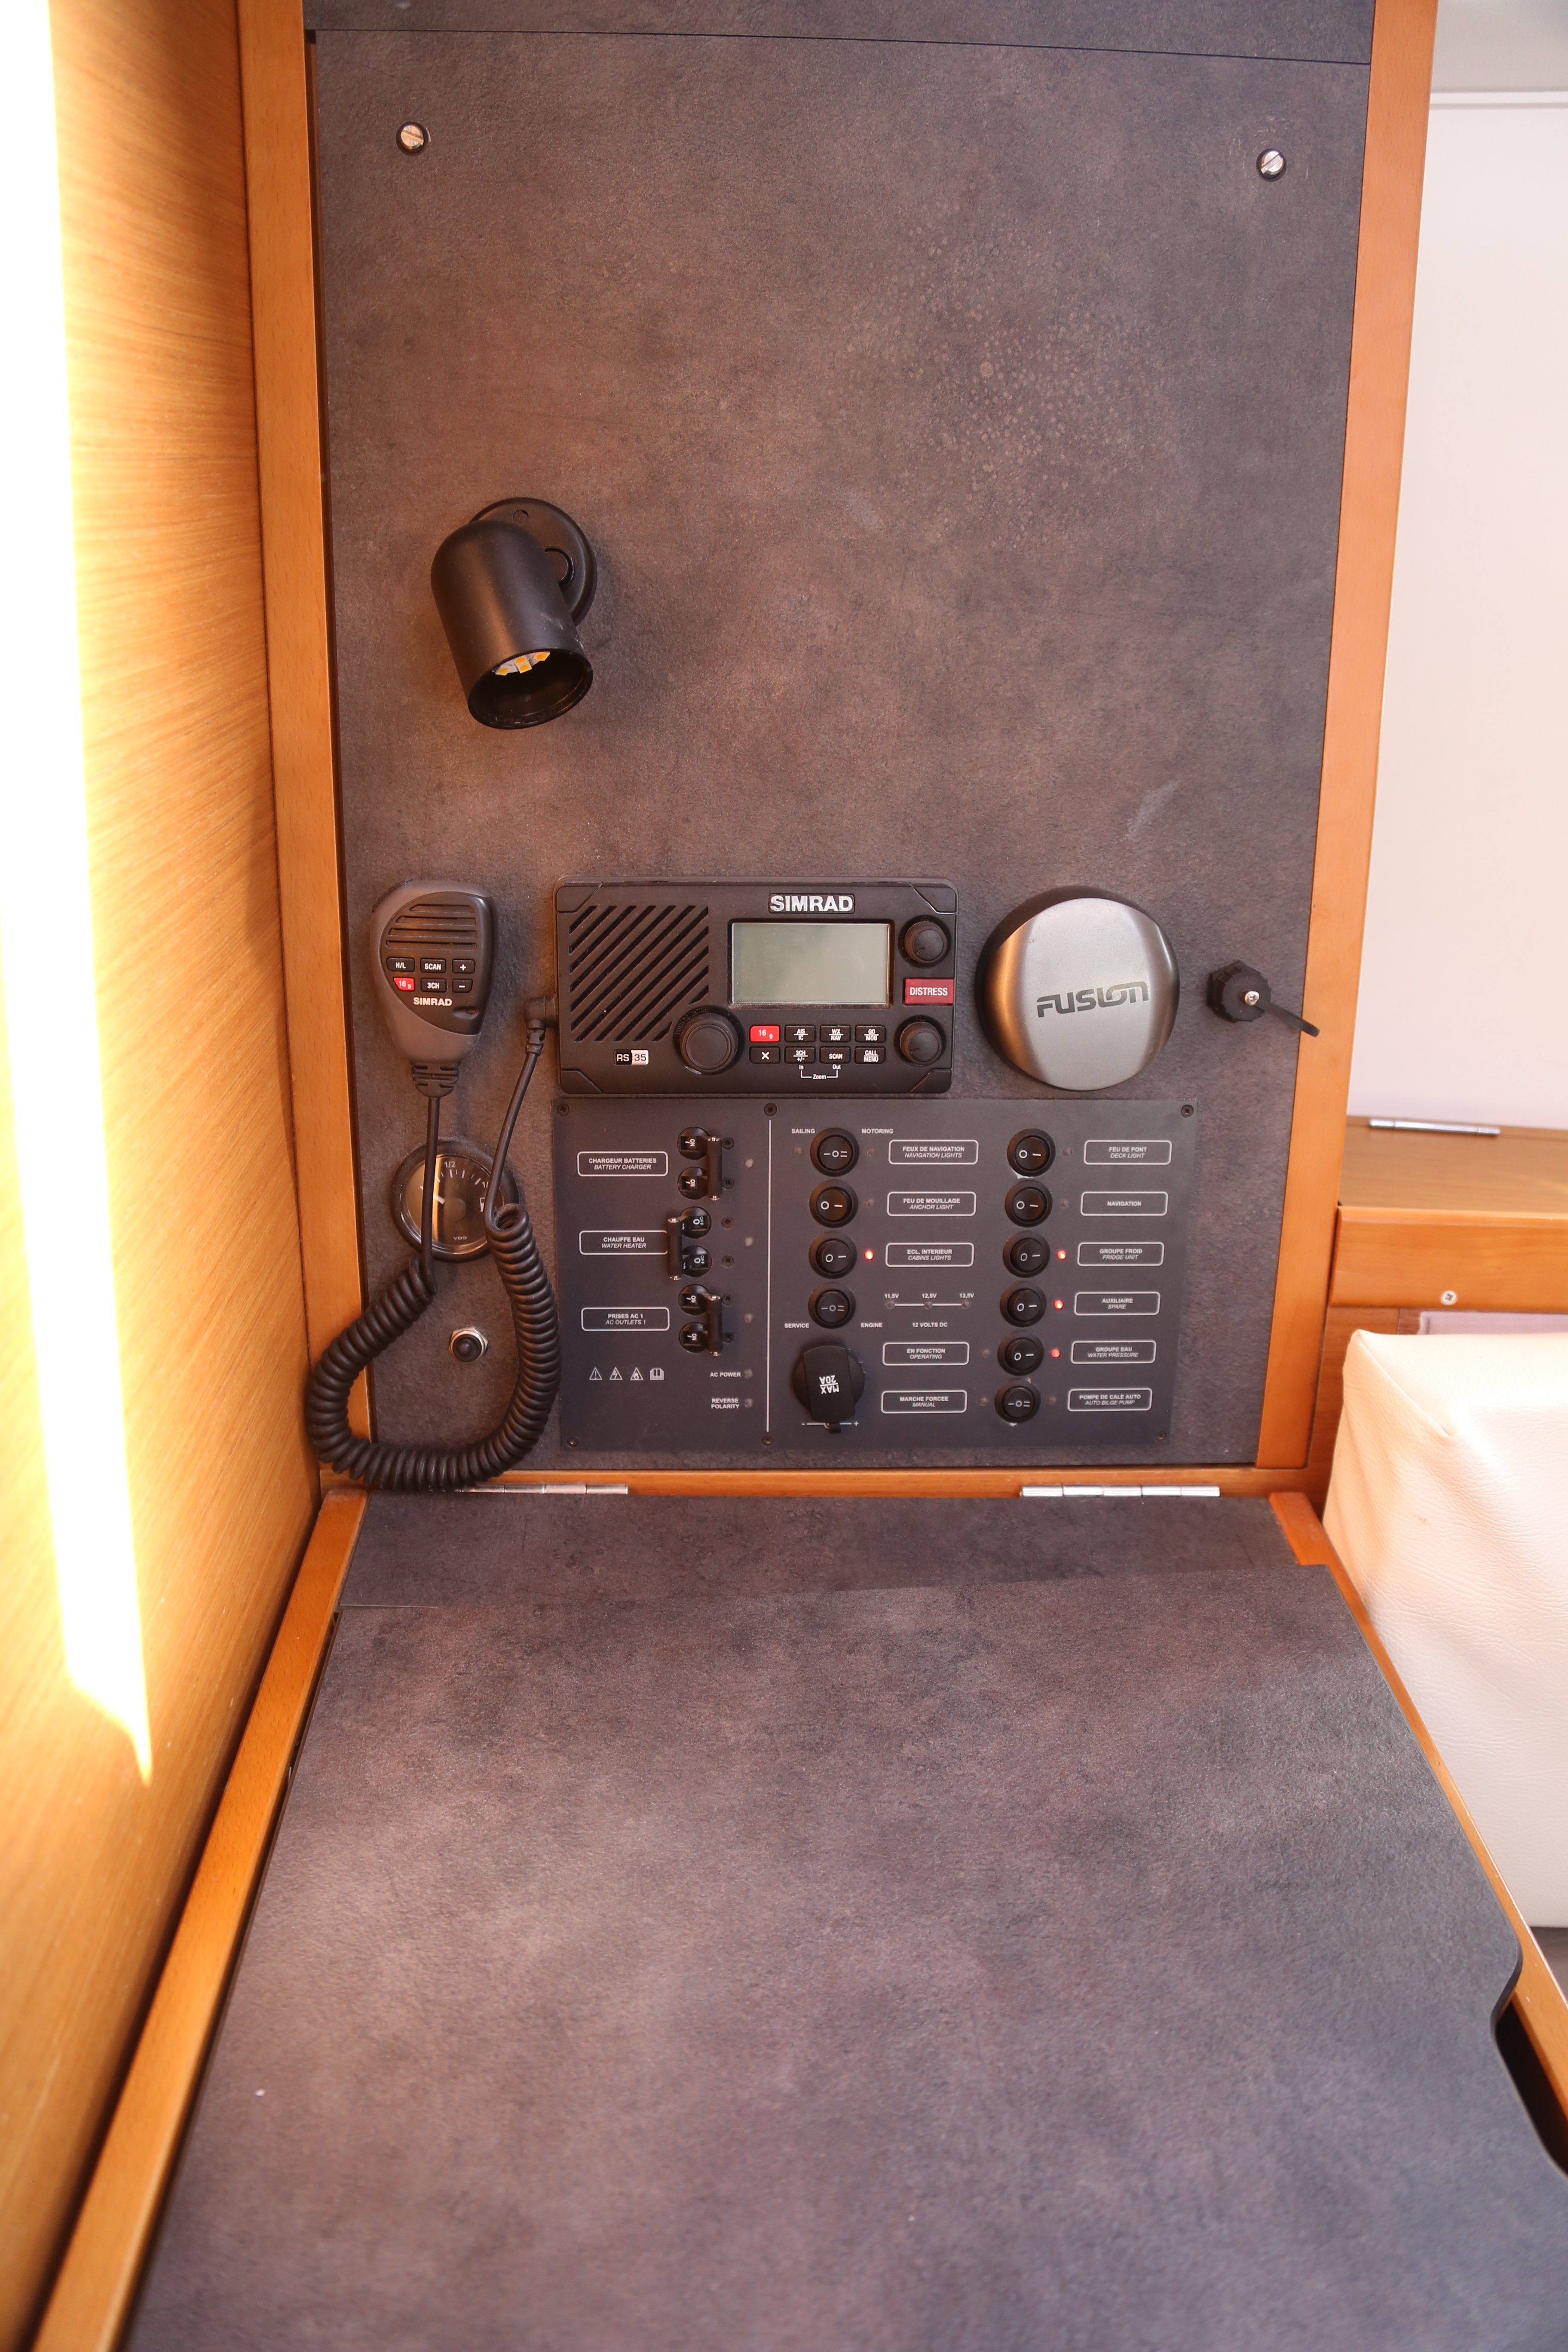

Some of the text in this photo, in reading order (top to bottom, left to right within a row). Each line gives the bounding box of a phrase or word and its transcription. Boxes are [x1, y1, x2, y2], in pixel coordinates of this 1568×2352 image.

[770, 895, 853, 912] SIMRAD
[910, 986, 948, 996] DISTRESS
[413, 997, 453, 1006] SIMRAD
[1036, 981, 1149, 1018] FUSION
[616, 1054, 646, 1062] RS 35
[689, 1139, 695, 1147] ON
[690, 1179, 695, 1187] ON
[691, 1295, 696, 1303] ON
[692, 1333, 697, 1341] ON
[819, 1375, 836, 1385] 20A
[820, 1384, 840, 1395] MAX
